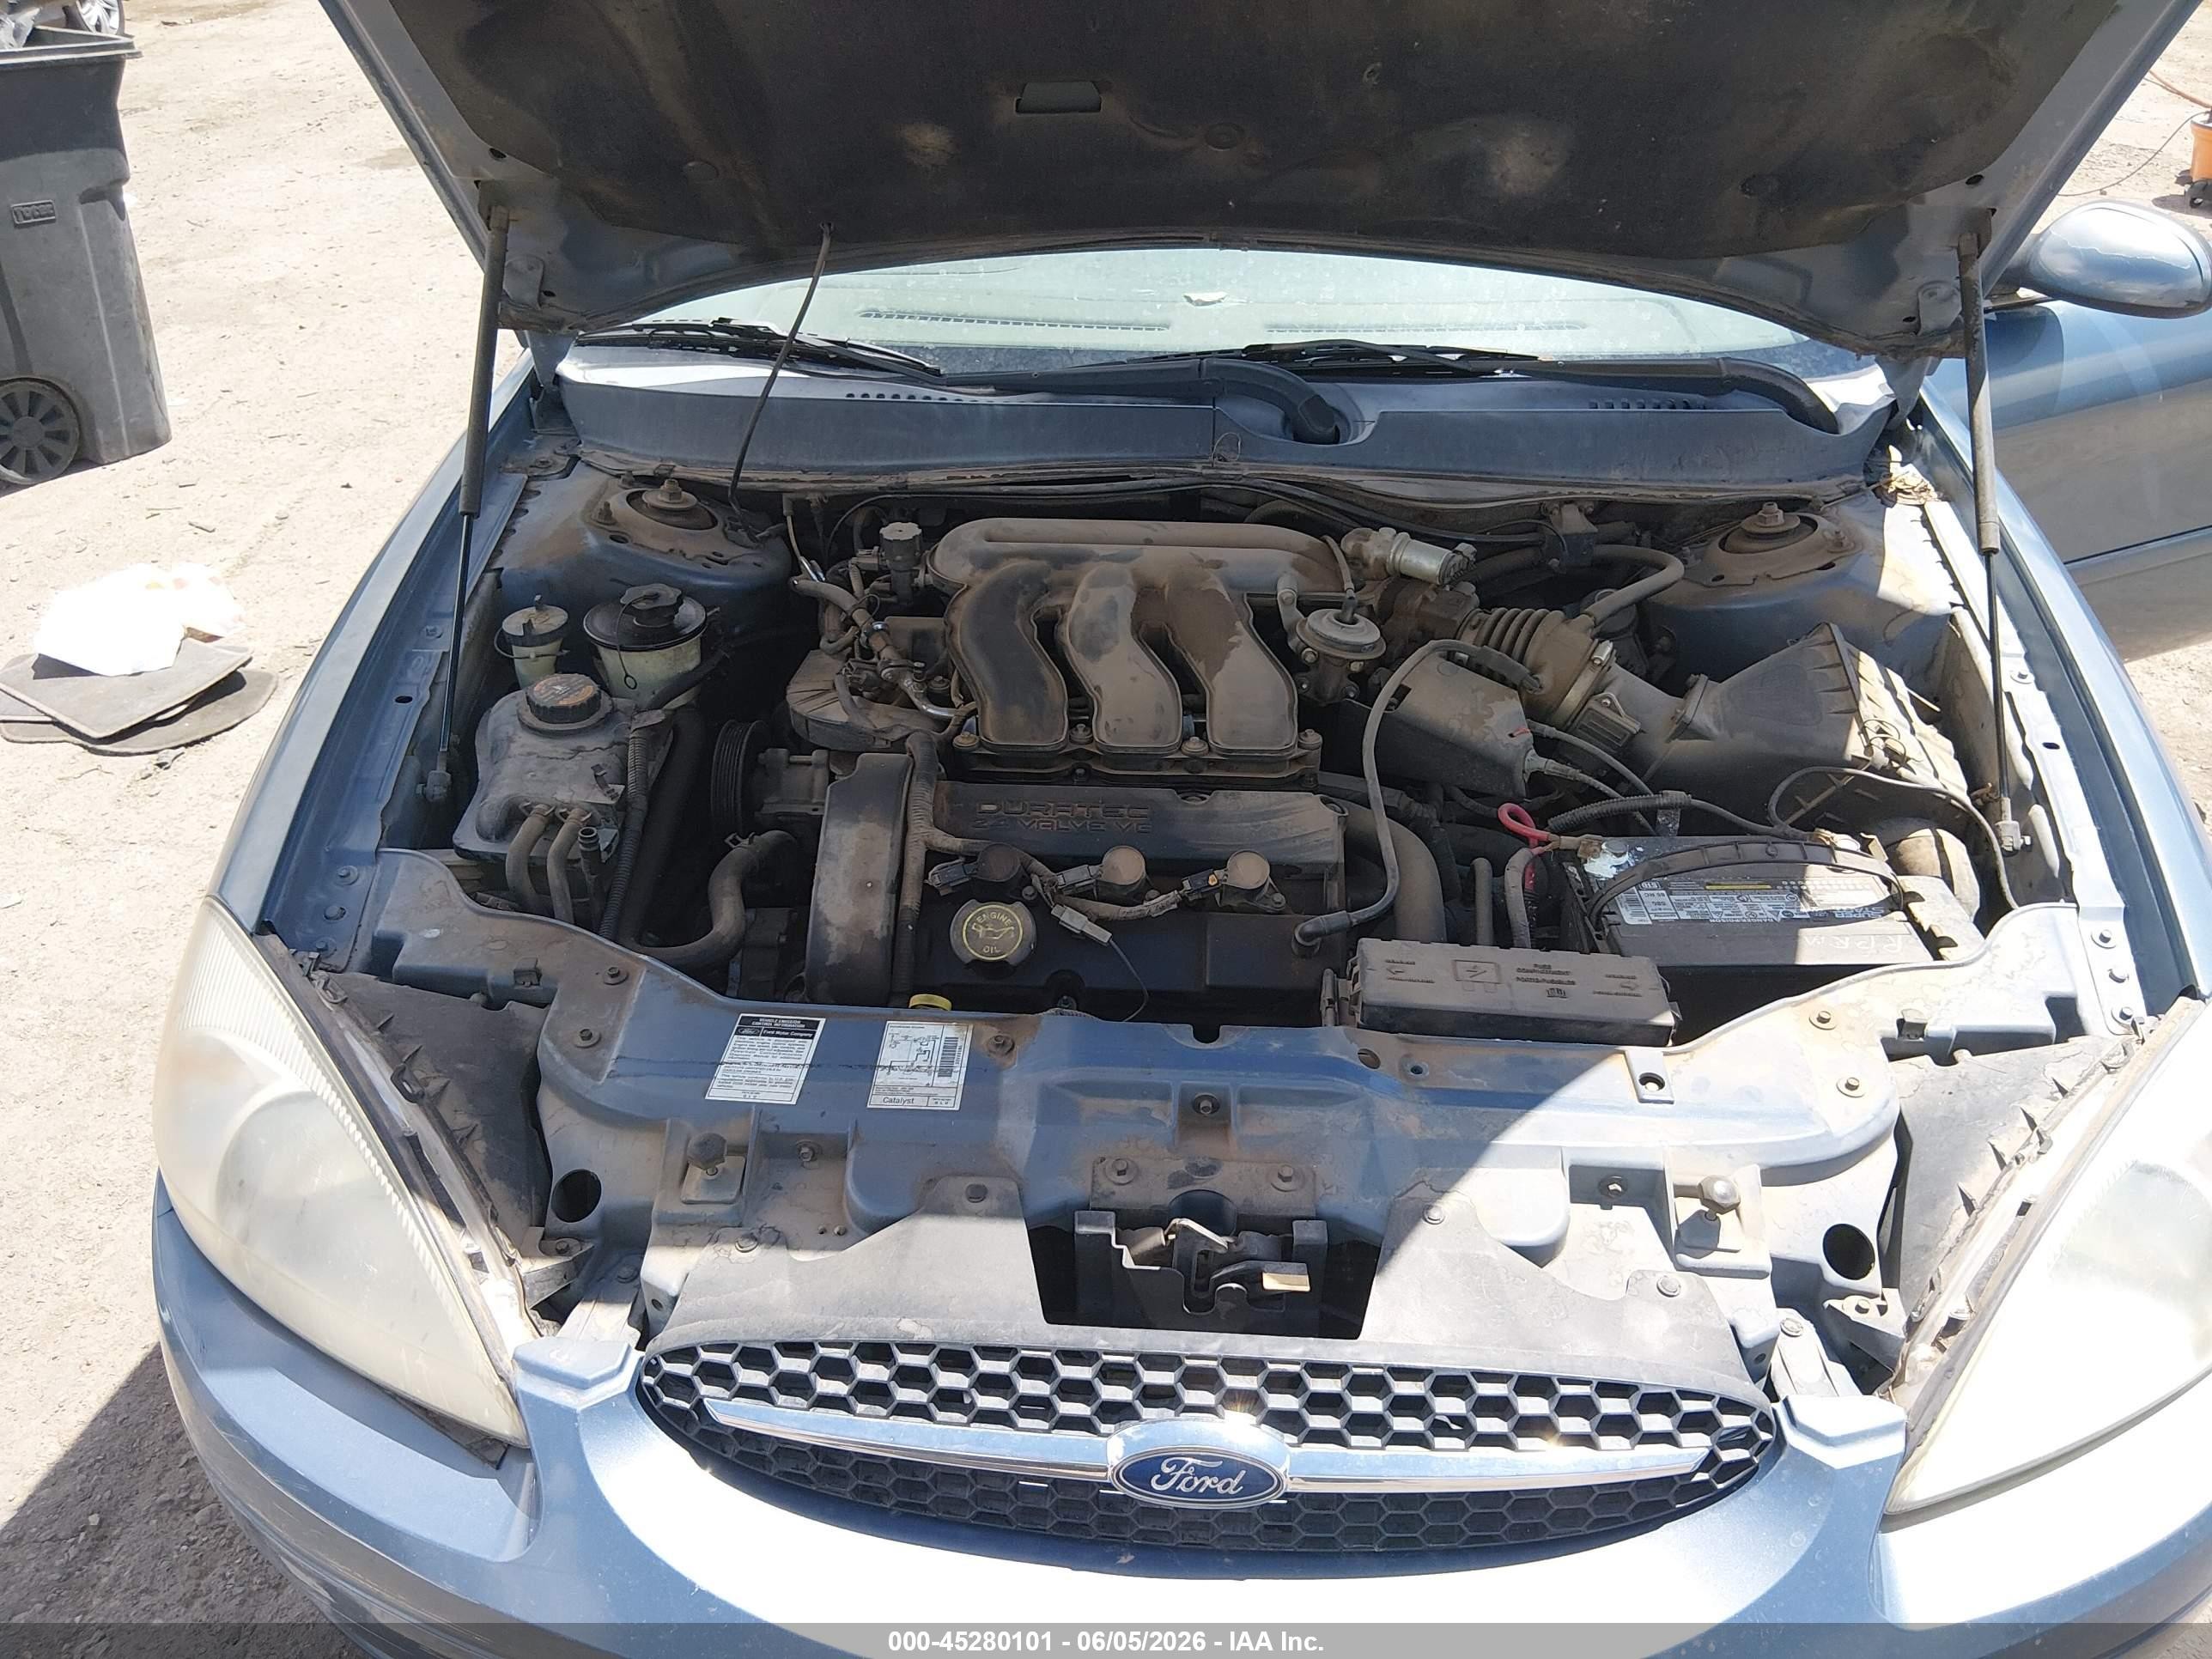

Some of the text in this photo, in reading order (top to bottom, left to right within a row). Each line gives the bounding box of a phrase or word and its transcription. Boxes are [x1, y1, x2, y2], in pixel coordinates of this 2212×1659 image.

[975, 803, 1149, 819] DURATEC
[976, 911, 1014, 927] ENGINE
[982, 945, 1004, 954] OIL
[883, 1097, 915, 1106] Catalyst
[1151, 1456, 1246, 1495] Ford
